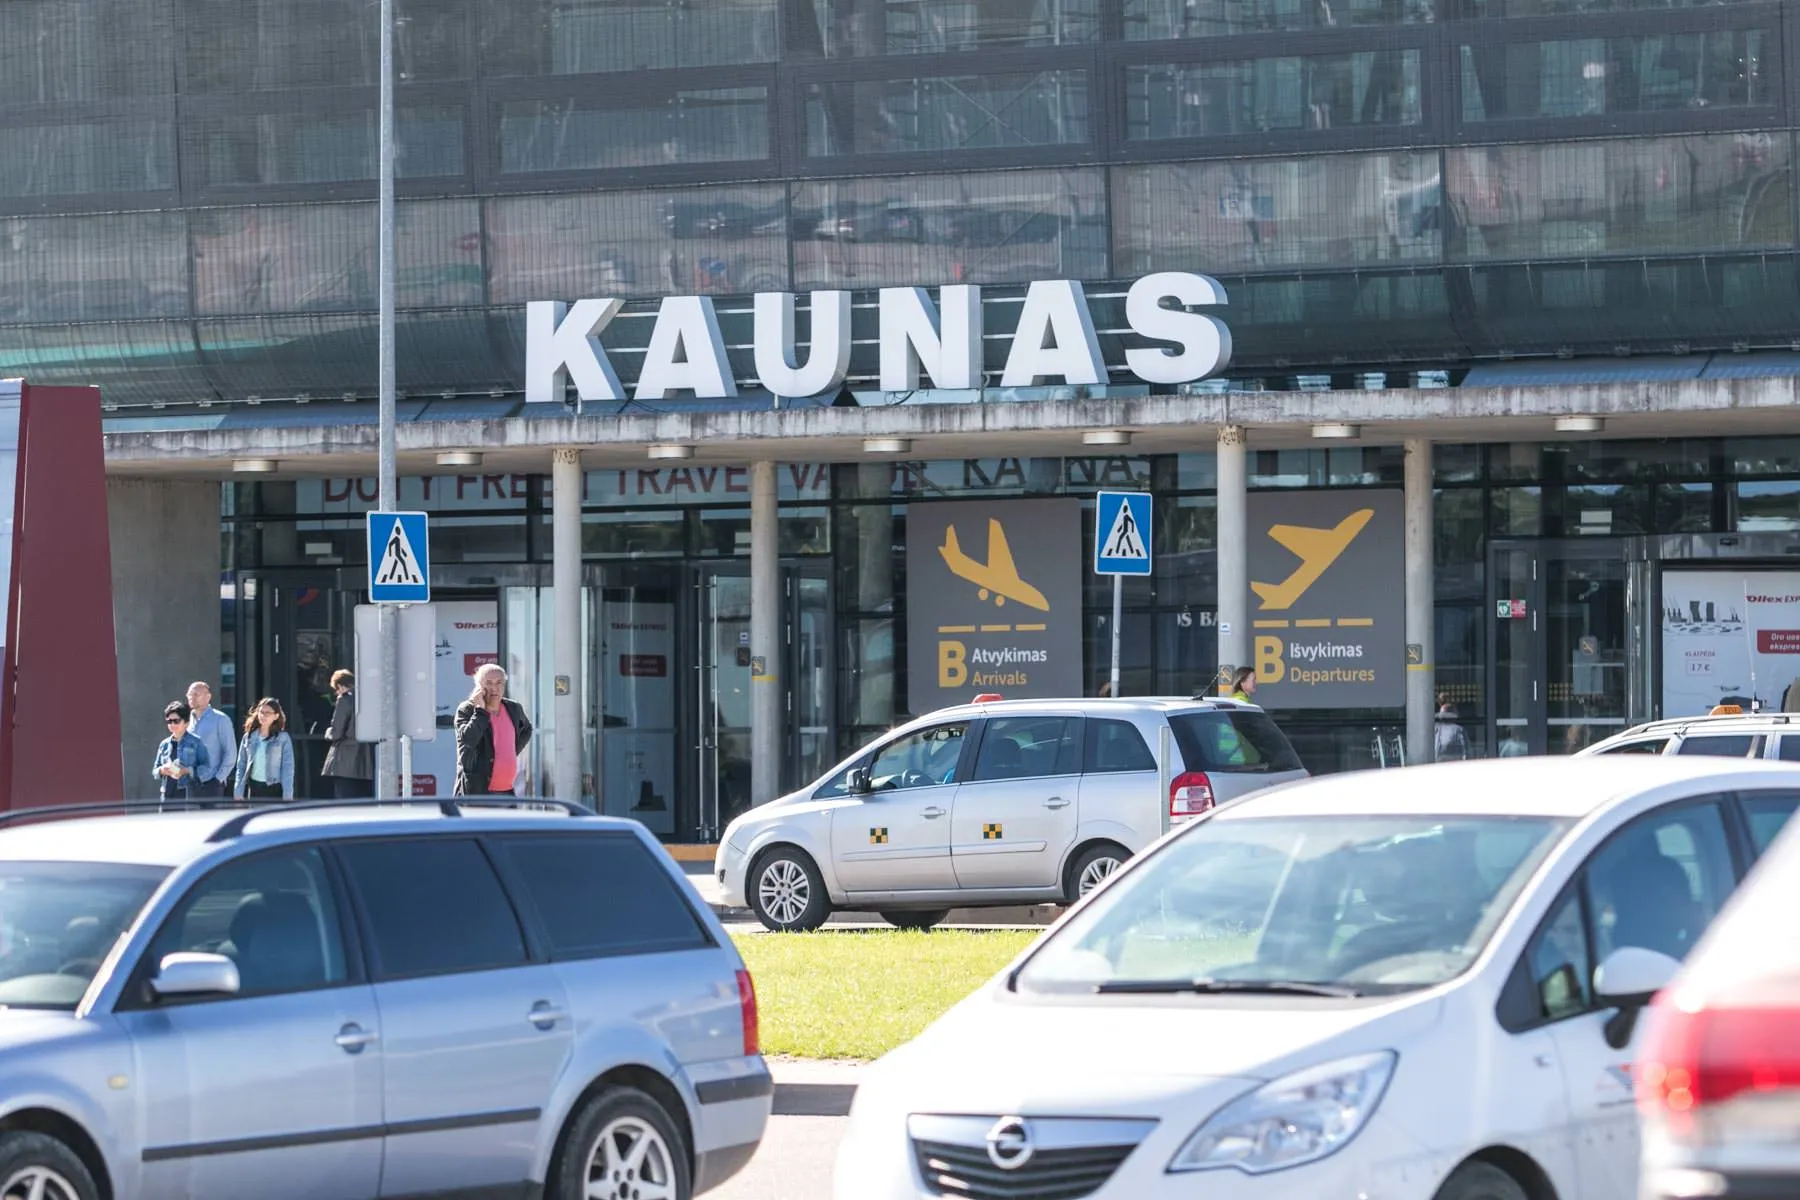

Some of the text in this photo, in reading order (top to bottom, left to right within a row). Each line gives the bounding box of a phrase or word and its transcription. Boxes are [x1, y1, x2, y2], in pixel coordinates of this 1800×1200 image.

[526, 271, 1231, 401] KAUNAS
[971, 647, 1048, 667] Atvykimas
[1255, 635, 1286, 684] B
[1290, 642, 1363, 662] Išvykimas
[938, 640, 968, 688] B
[971, 670, 1028, 686] Arrivals
[1290, 667, 1375, 685] Departures
